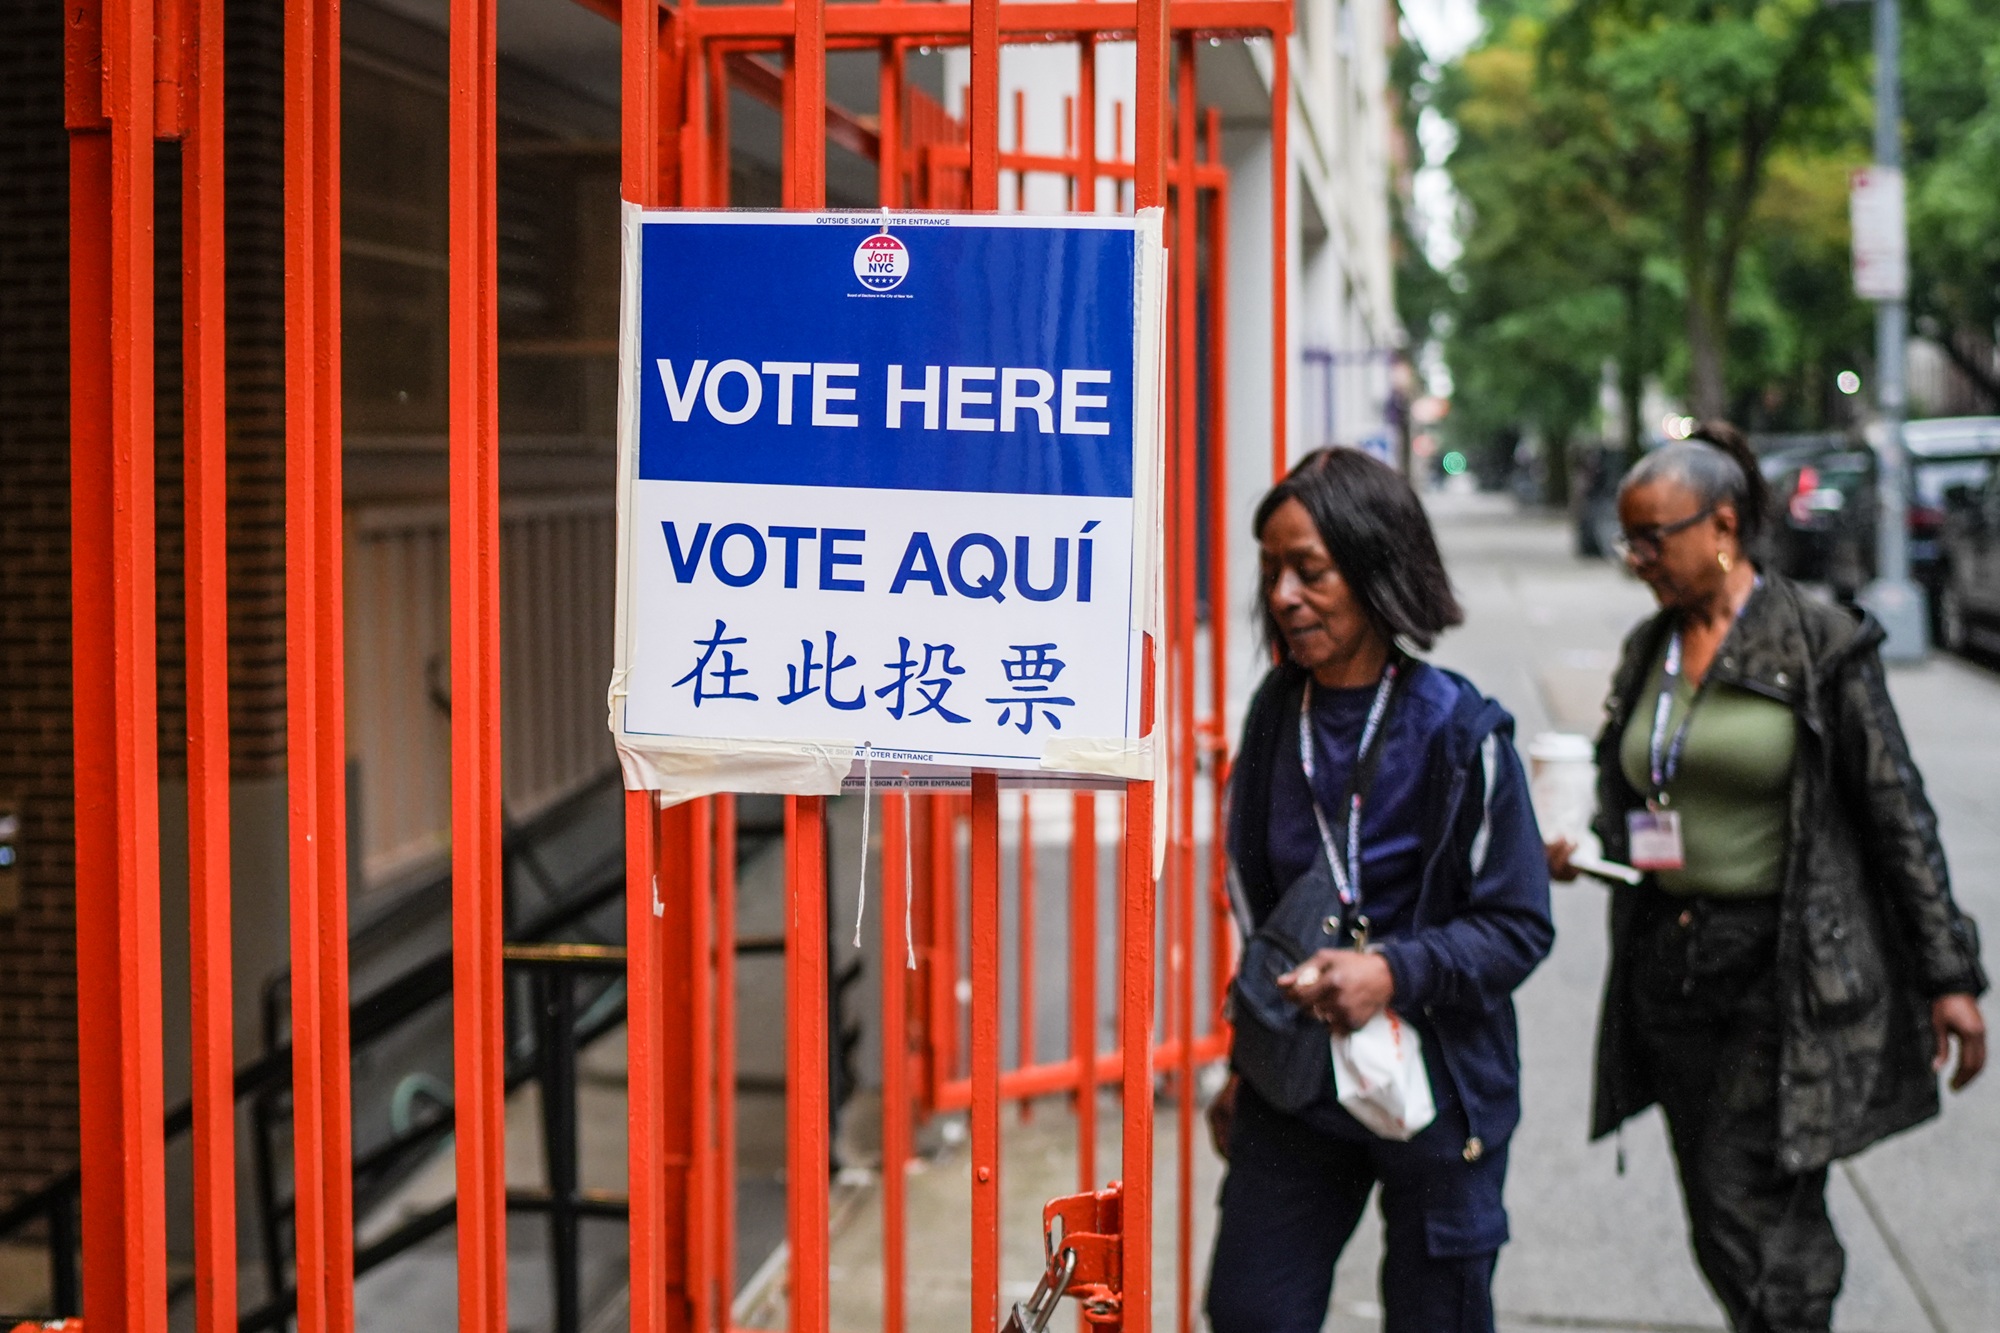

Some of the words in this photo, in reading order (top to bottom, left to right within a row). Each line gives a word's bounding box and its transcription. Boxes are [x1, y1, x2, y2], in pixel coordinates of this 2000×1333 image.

[816, 217, 849, 225] OUTSIDE
[850, 217, 870, 225] SIGN
[909, 218, 951, 226] ENTRANCE
[868, 263, 894, 273] NYC
[656, 358, 860, 428] VOTE
[885, 364, 1111, 436] HERE
[660, 520, 866, 593] VOTE
[888, 520, 1102, 605] AQUÍ
[671, 618, 1076, 736] 在此投票
[892, 752, 934, 762] ENTRANCE
